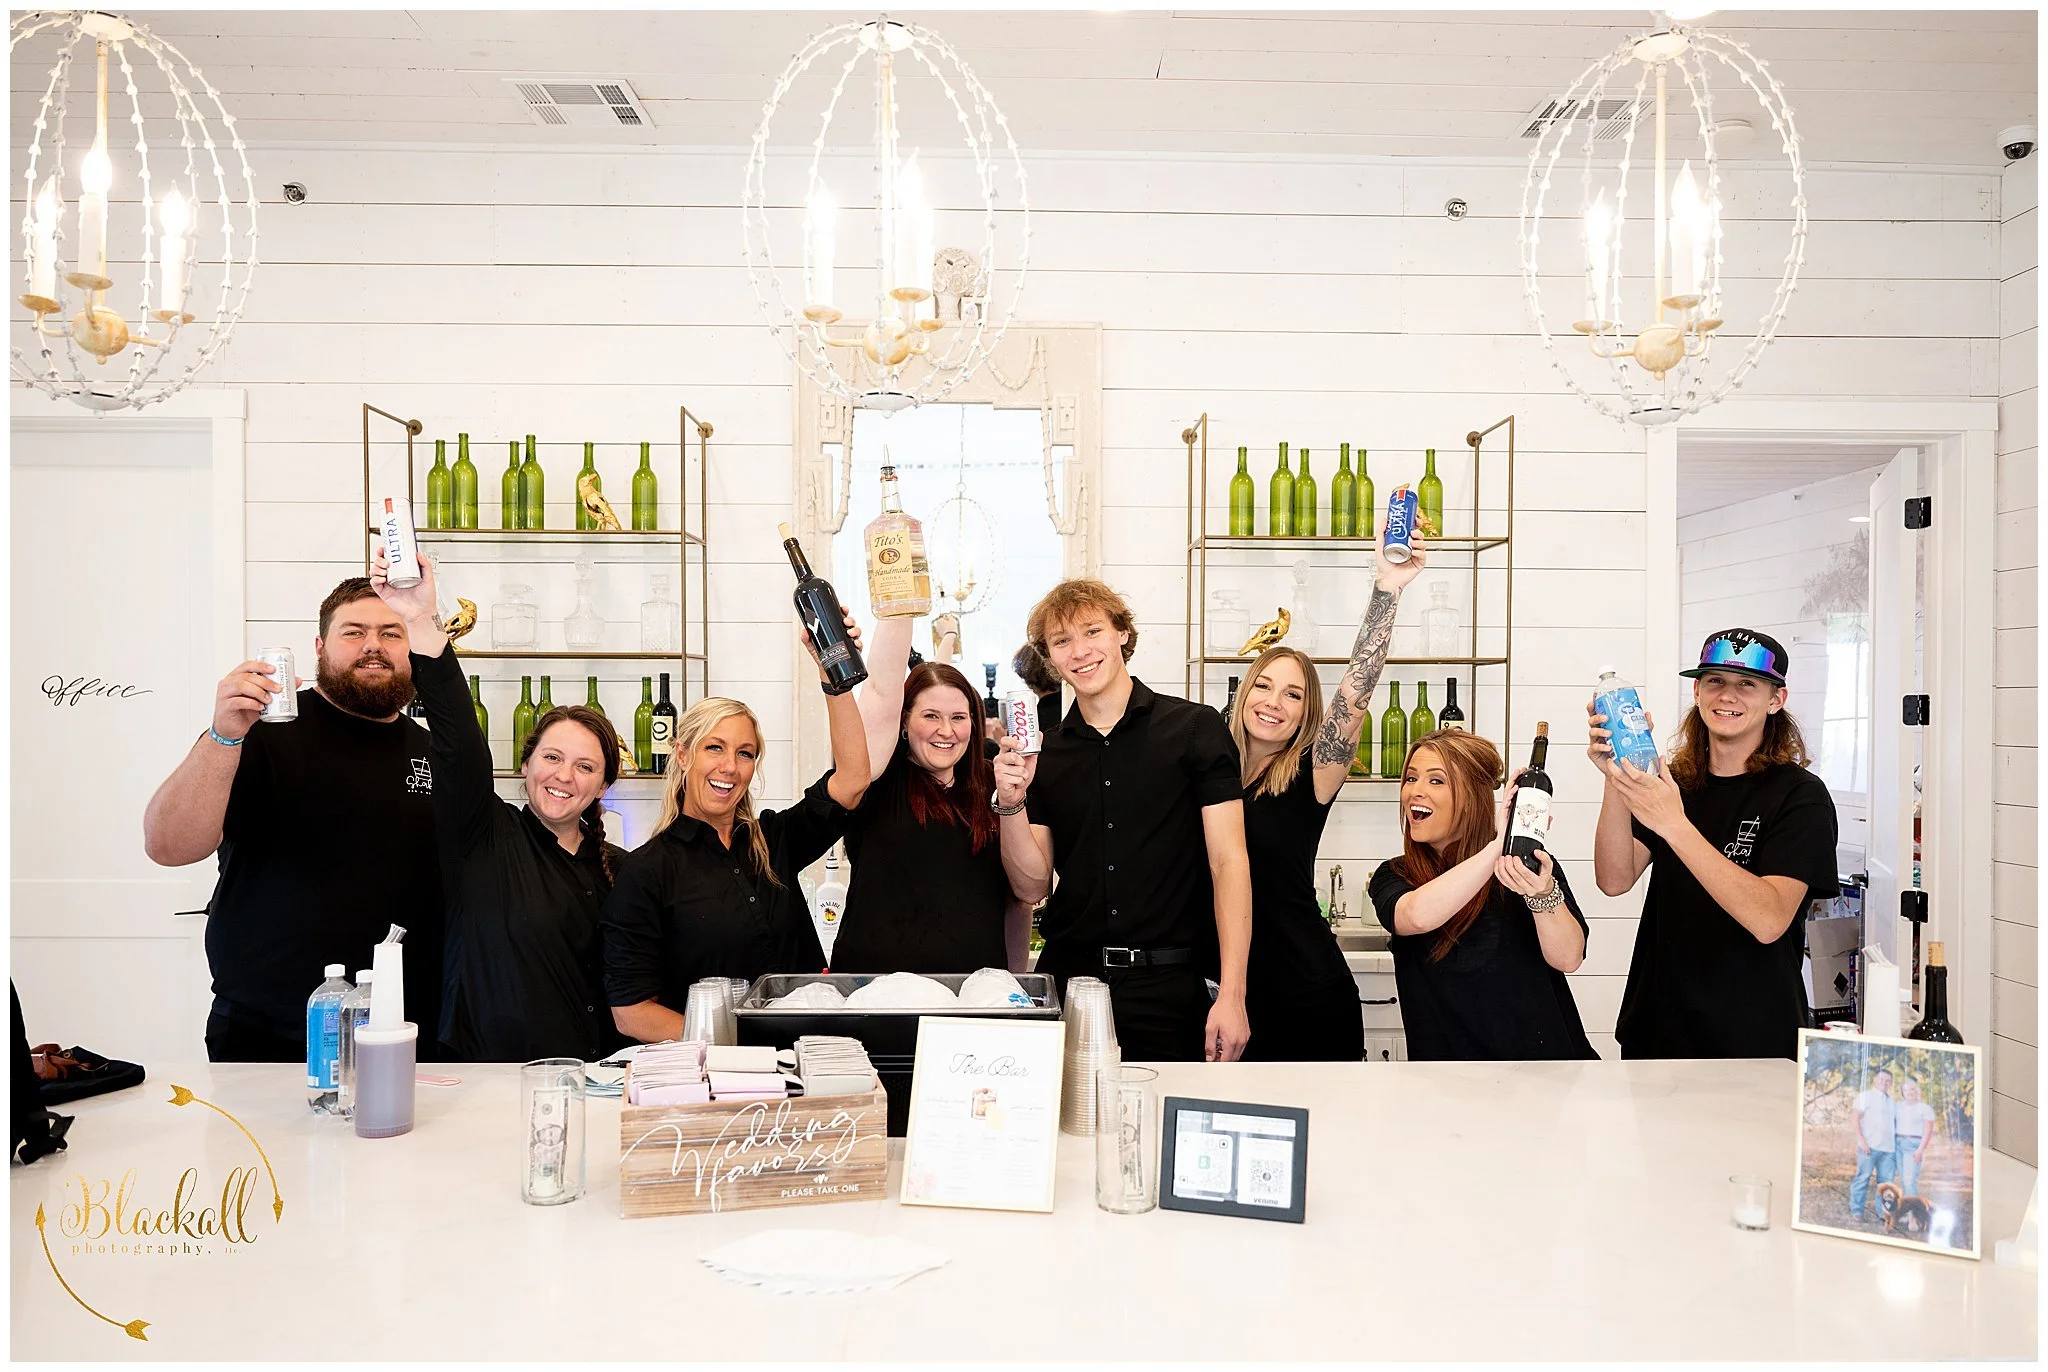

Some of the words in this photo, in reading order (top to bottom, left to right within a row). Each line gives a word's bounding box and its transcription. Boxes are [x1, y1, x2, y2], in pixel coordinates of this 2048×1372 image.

[1391, 501, 1405, 535] ULTRA
[387, 518, 402, 564] ULTRA
[874, 534, 903, 548] Tito's
[874, 564, 911, 577] Handmade
[41, 674, 153, 707] Office
[1028, 713, 1036, 738] LIGHT
[949, 1053, 985, 1075] The
[987, 1055, 1030, 1077] Bar
[619, 1099, 882, 1198] Wedding
[709, 1139, 836, 1213] favors
[781, 1186, 814, 1198] PLEASE
[817, 1185, 839, 1195] TAKE
[842, 1183, 860, 1193] ONE
[1253, 1197, 1279, 1206] venmo
